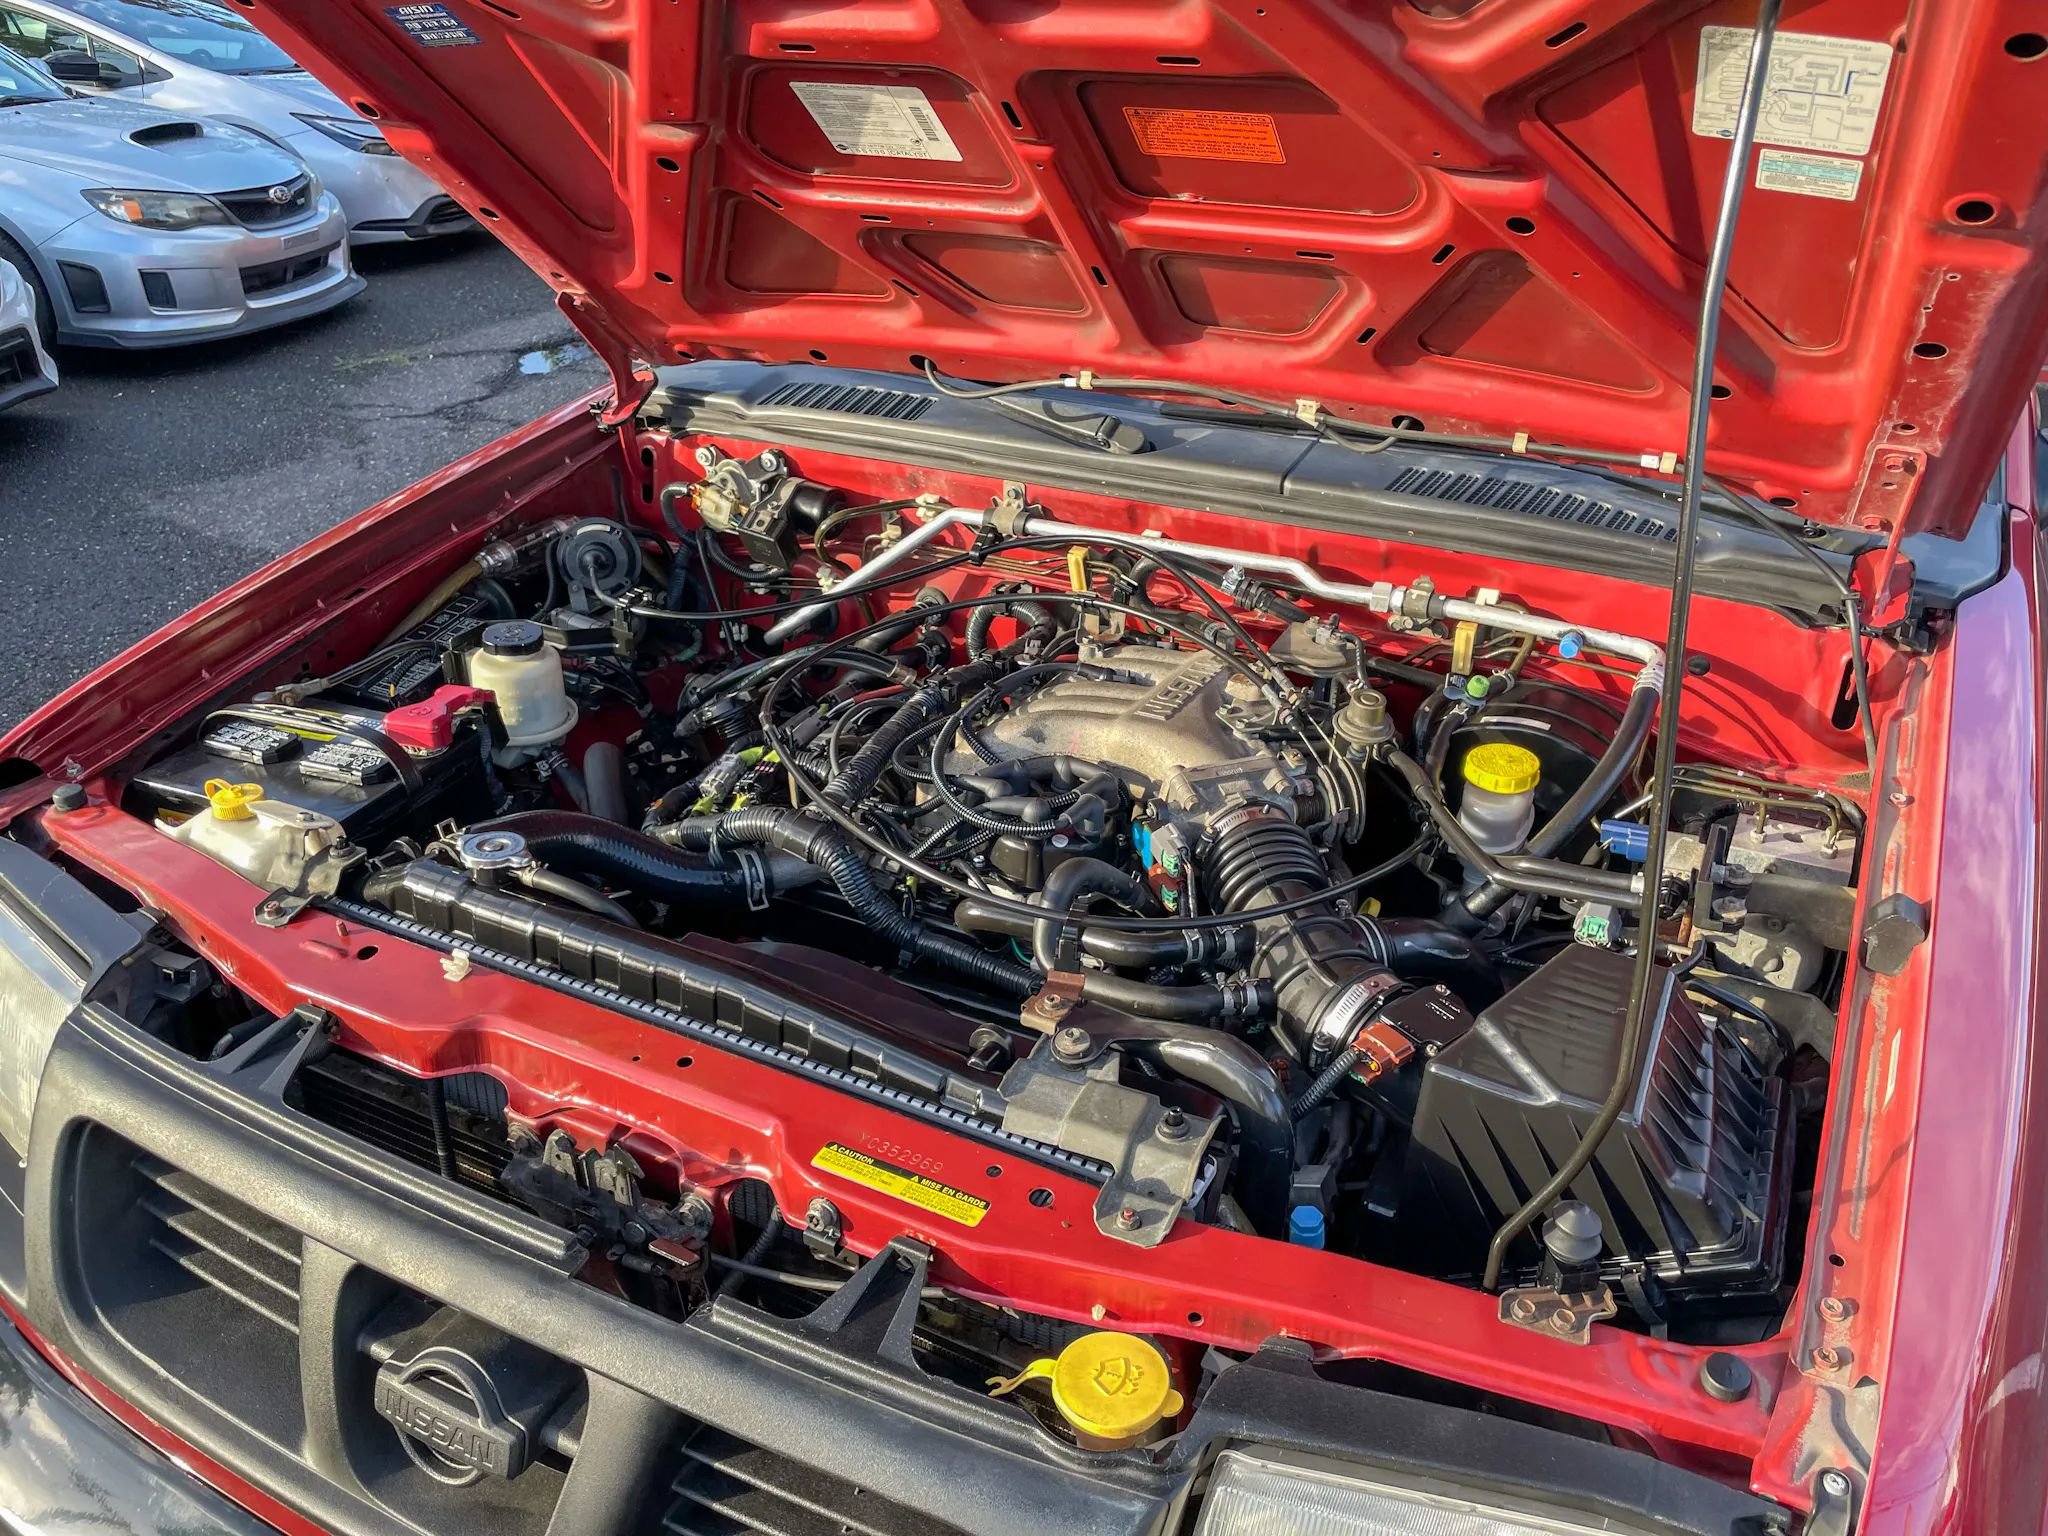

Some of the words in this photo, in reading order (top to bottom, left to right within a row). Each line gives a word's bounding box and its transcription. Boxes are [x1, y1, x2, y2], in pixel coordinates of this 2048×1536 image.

[1134, 661, 1223, 721] NISSAN
[838, 1146, 875, 1165] CAUTION
[920, 1178, 942, 1191] MISE
[942, 1186, 955, 1196] EN
[955, 1192, 987, 1209] GARDE
[385, 1388, 496, 1468] NISSAN
